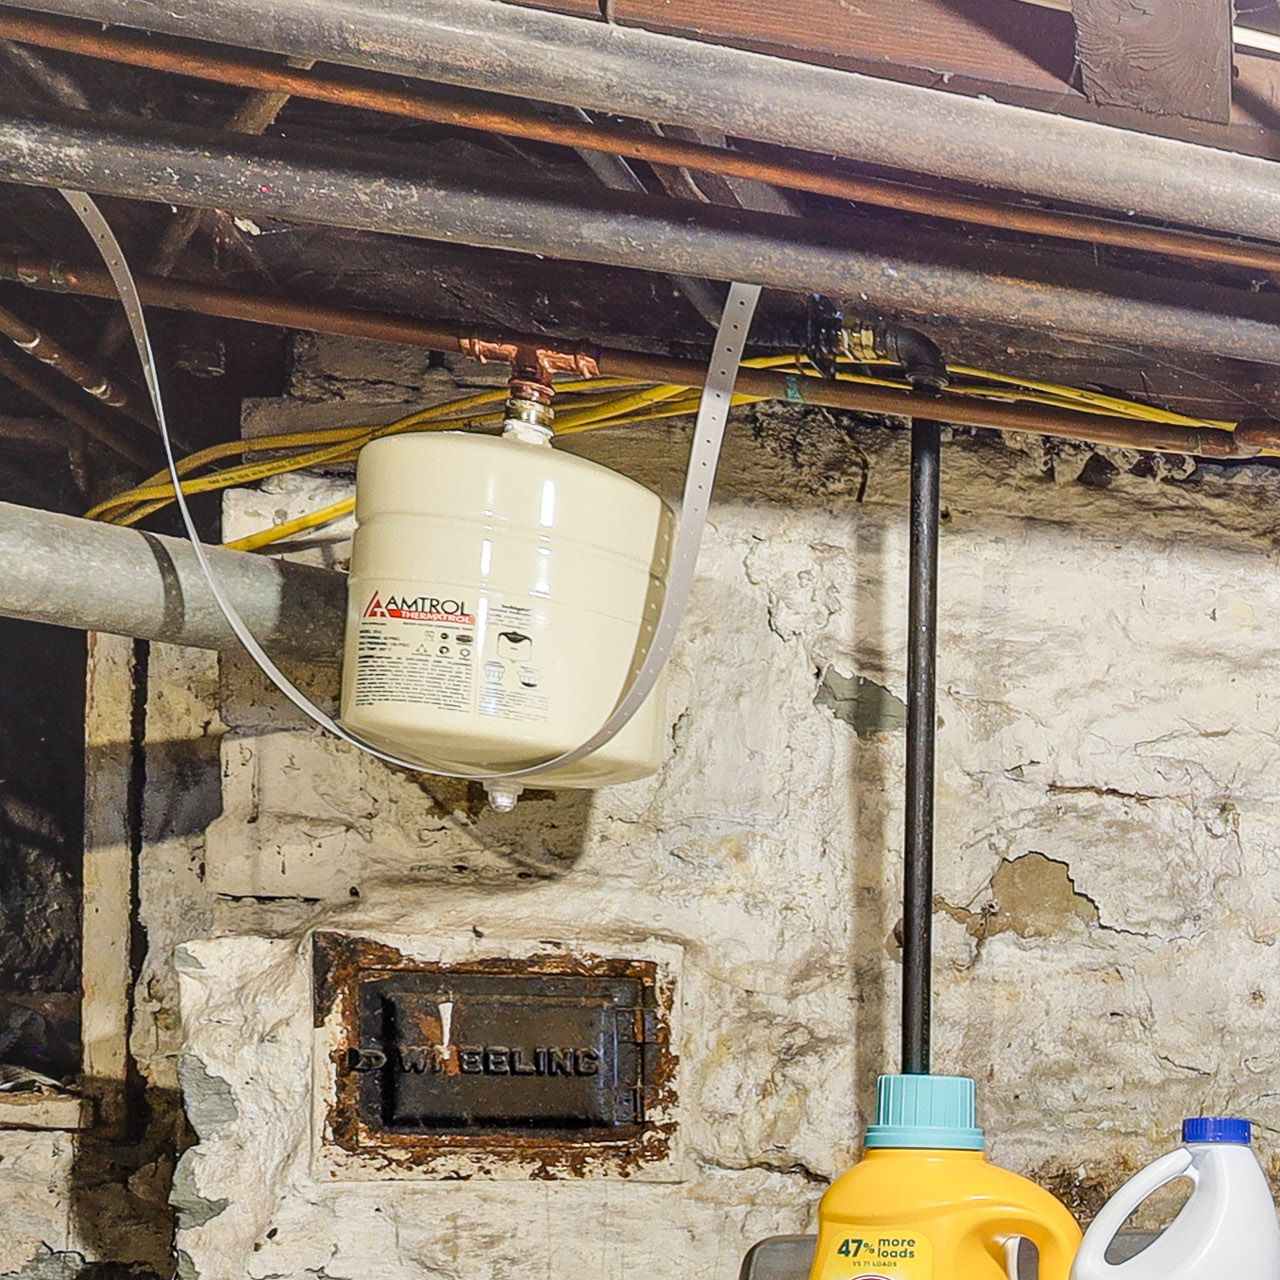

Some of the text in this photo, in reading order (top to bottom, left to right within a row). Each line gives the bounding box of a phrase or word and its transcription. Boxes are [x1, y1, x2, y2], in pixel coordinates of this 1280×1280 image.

[385, 595, 467, 615] AMTROL
[837, 1238, 875, 1258] 47%
[878, 1238, 916, 1247] more
[878, 1247, 915, 1259] loads
